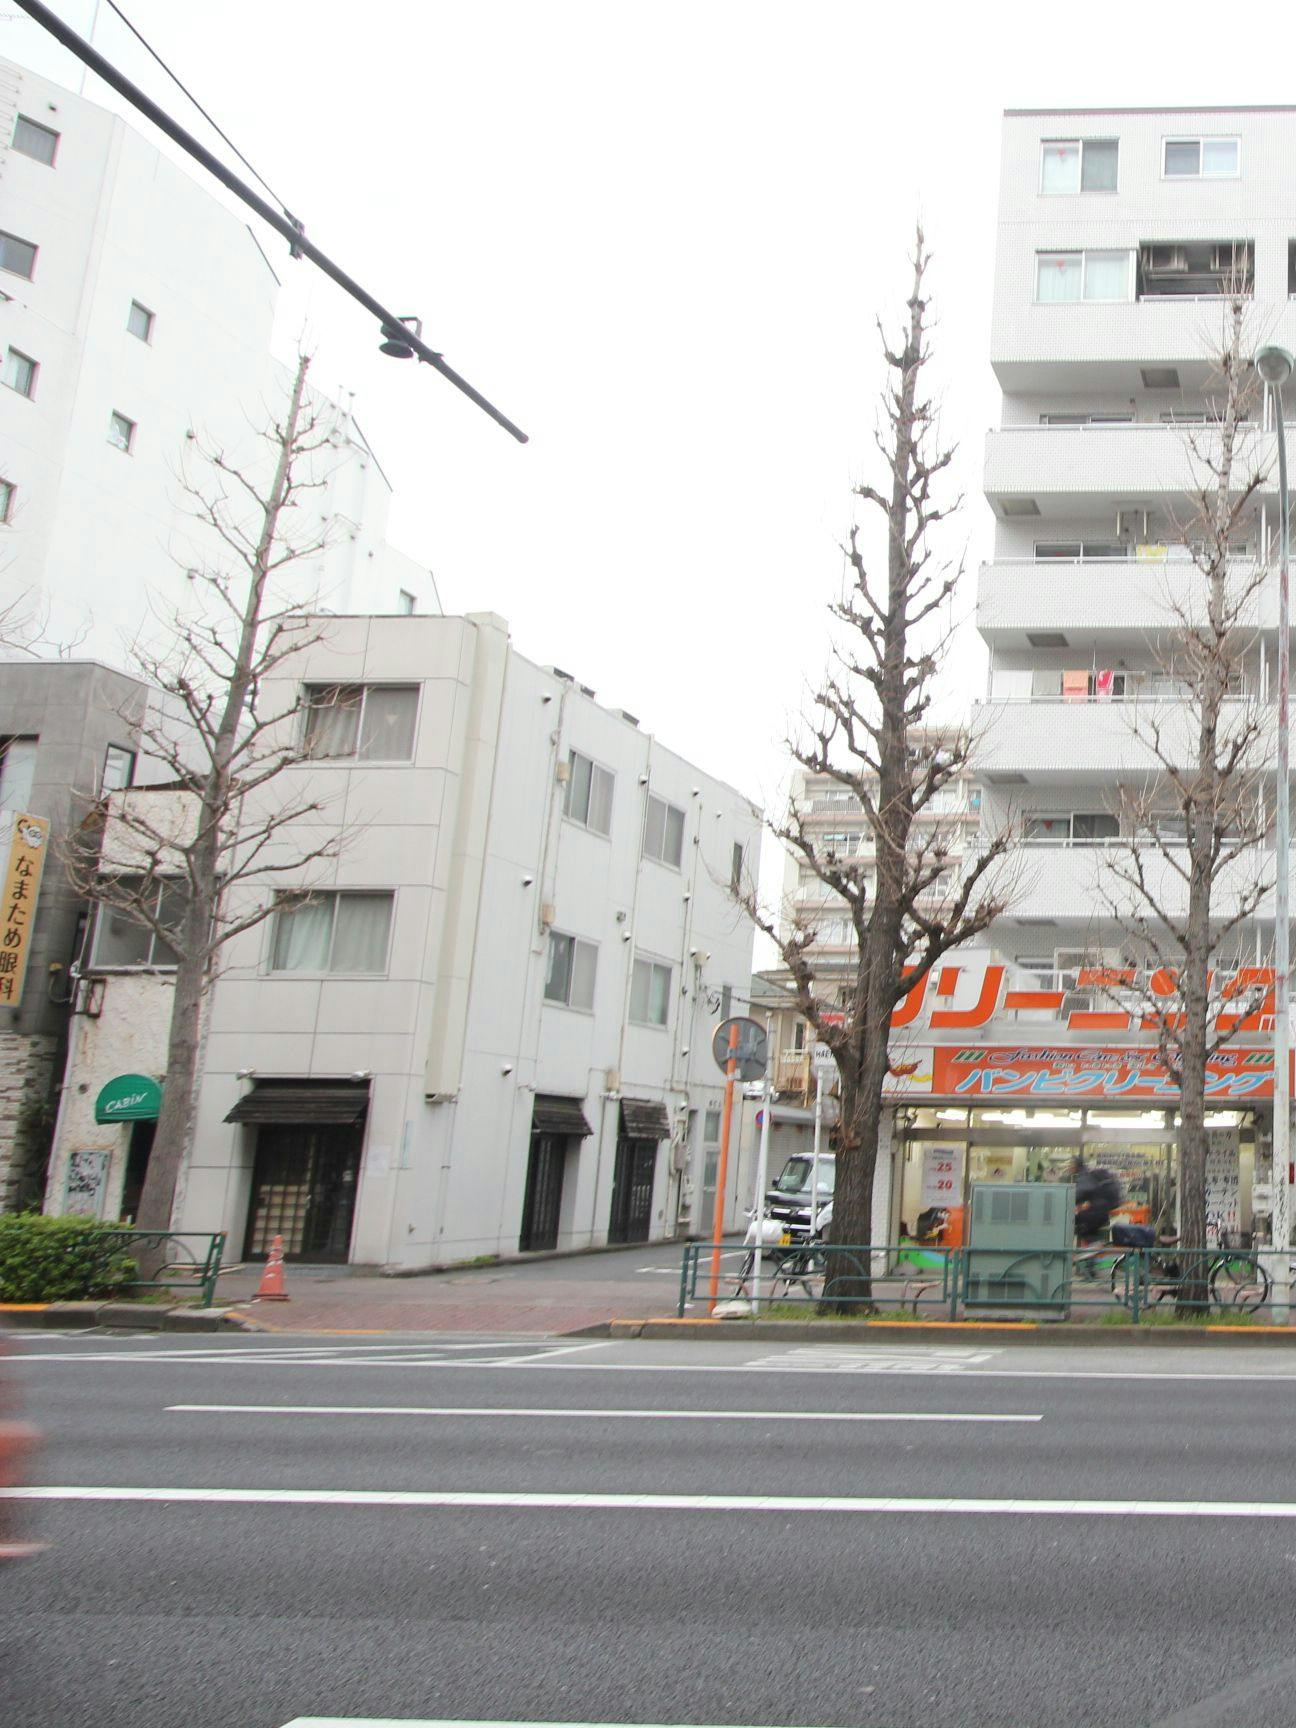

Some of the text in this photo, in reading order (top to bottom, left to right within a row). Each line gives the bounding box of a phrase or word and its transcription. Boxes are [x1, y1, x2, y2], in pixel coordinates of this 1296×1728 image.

[0, 855, 33, 1000] なまため眼科
